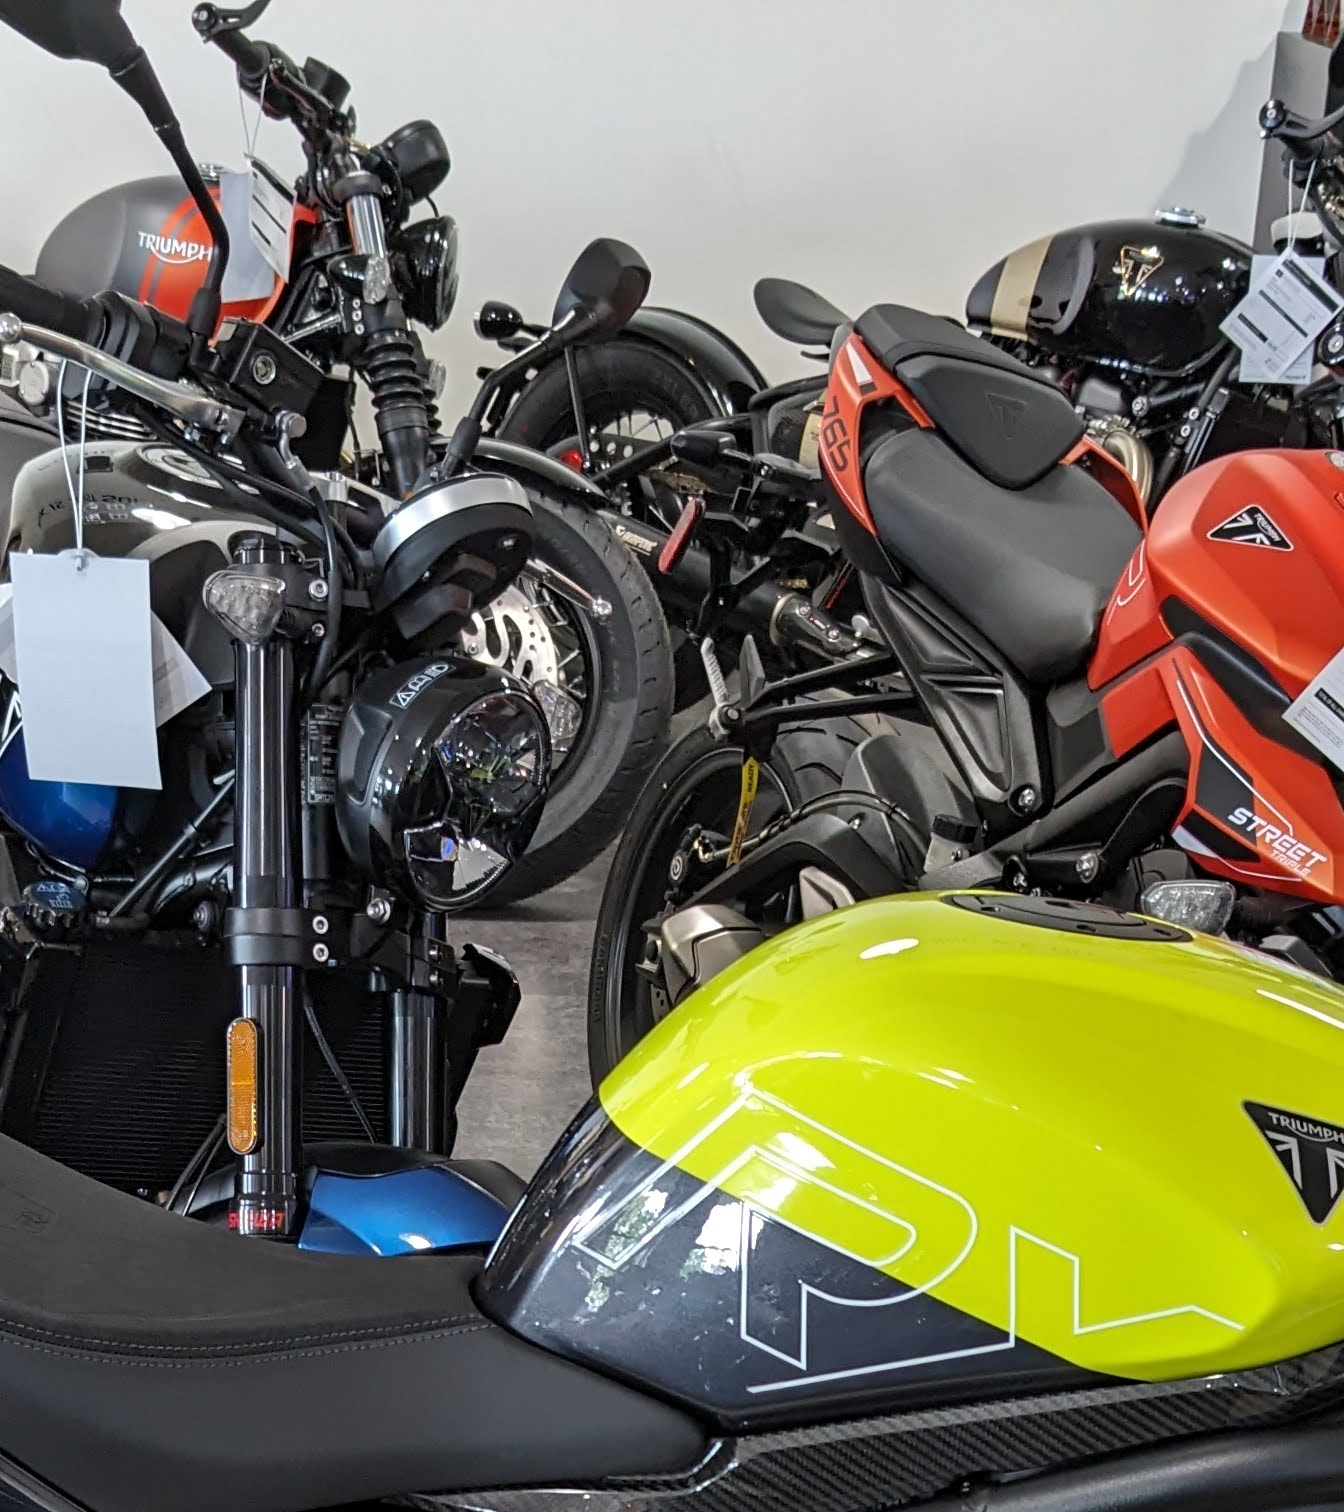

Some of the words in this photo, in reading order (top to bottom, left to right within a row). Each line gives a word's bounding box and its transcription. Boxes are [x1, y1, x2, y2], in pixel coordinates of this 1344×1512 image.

[138, 231, 212, 263] TRIUMPH
[824, 395, 850, 472] 765
[1227, 807, 1328, 868] STREET
[1271, 849, 1312, 877] TRIPLE
